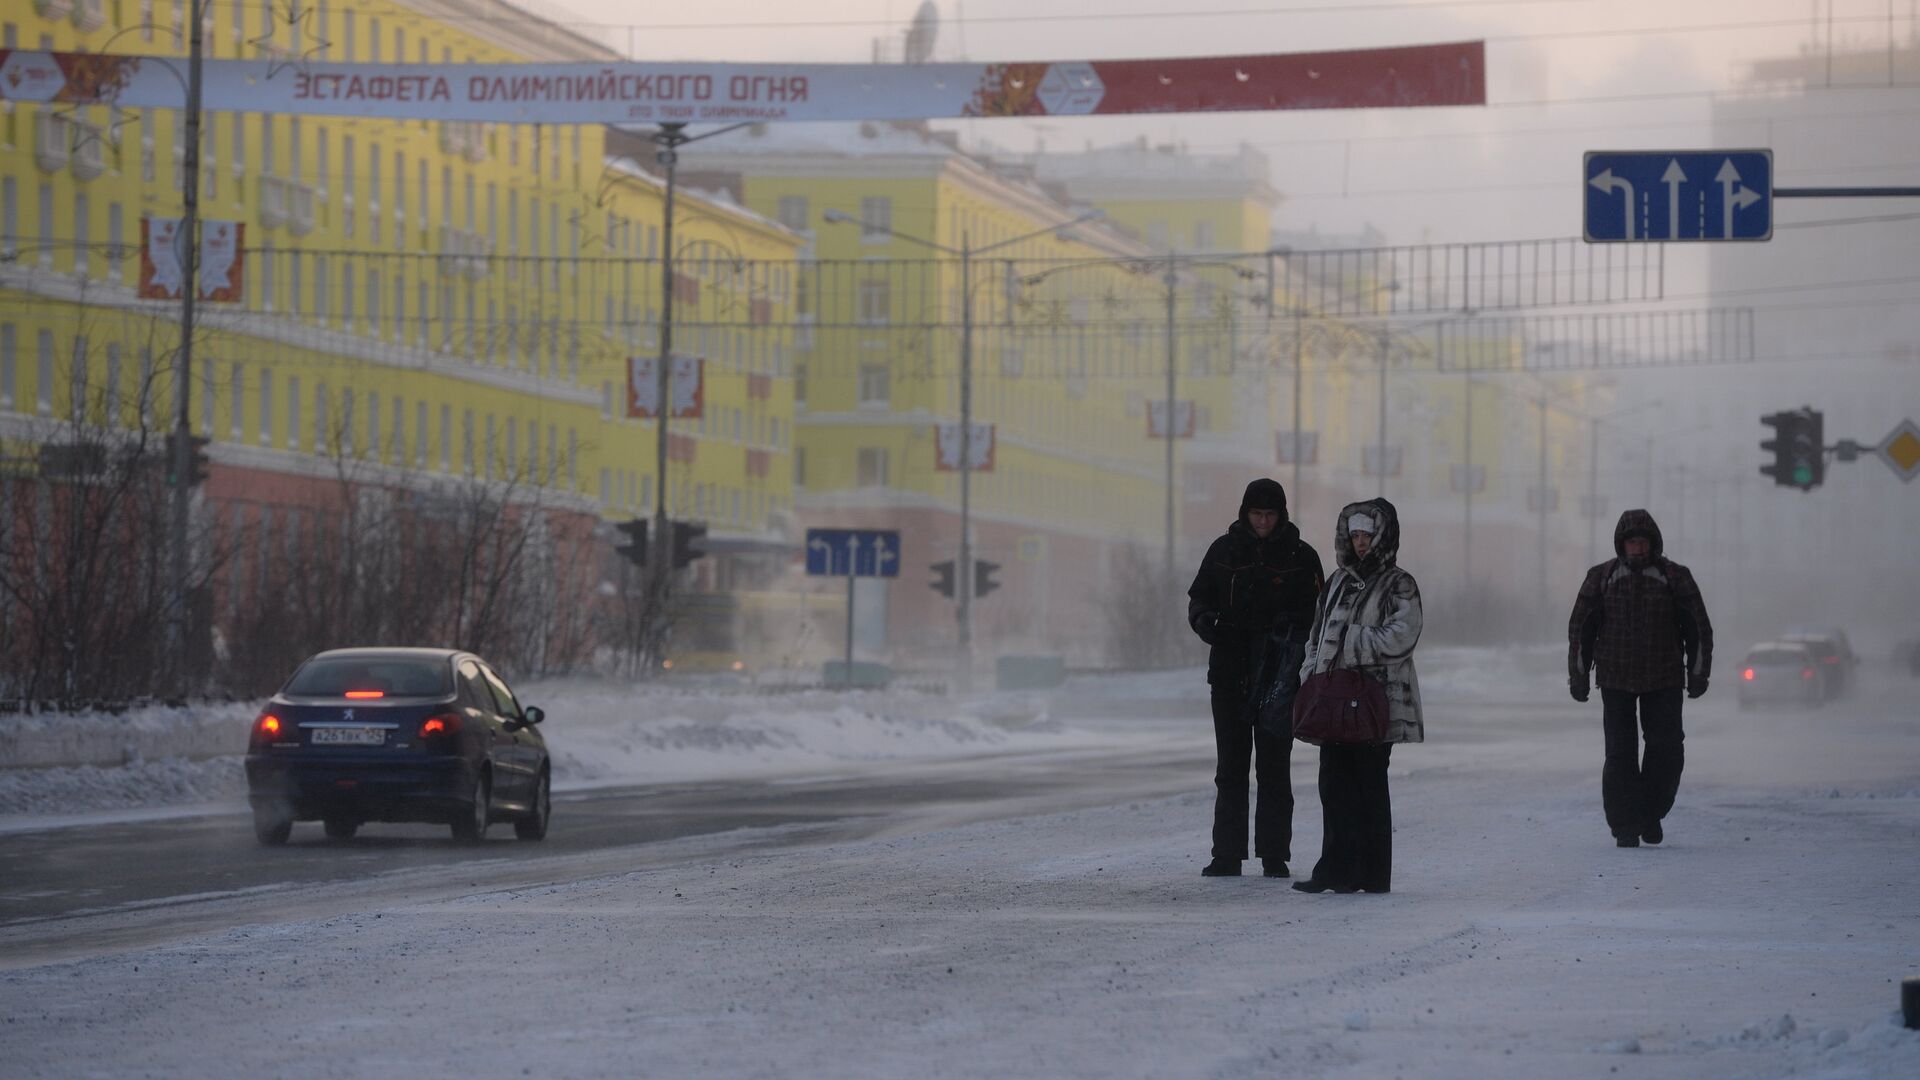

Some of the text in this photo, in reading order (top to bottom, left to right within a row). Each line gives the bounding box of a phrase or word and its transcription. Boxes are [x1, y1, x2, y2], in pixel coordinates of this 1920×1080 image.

[293, 69, 809, 102] ЭСТАФЕТА ОЛИМПИЙСКОГО ОГНЯ
